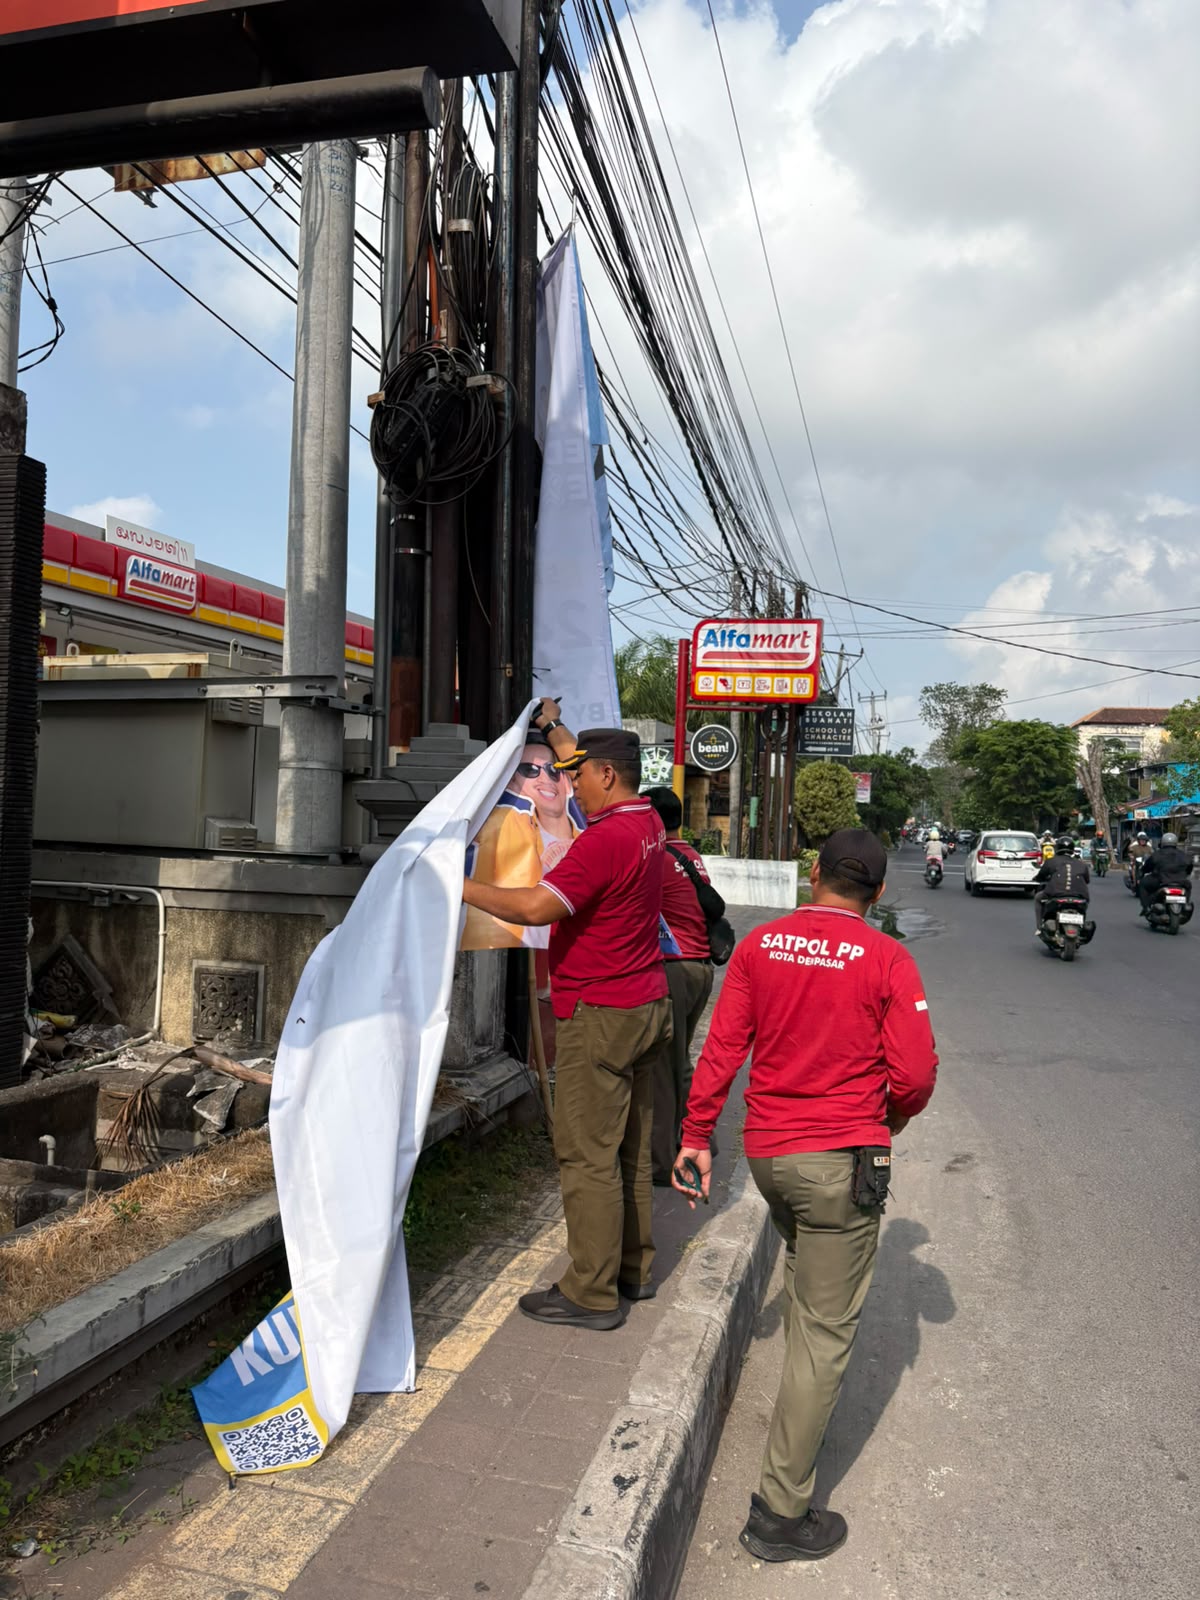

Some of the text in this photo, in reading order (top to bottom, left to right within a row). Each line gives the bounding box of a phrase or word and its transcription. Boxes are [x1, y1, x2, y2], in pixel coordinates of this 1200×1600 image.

[129, 558, 196, 593] Alfamart
[703, 628, 811, 650] Alfamart
[805, 710, 853, 718] SEKOLAH
[804, 727, 838, 735] SCHOOL
[804, 734, 852, 742] CHARACTER
[698, 741, 729, 753] bean!
[760, 933, 865, 961] SATPOL PP
[769, 950, 795, 963] KOTA
